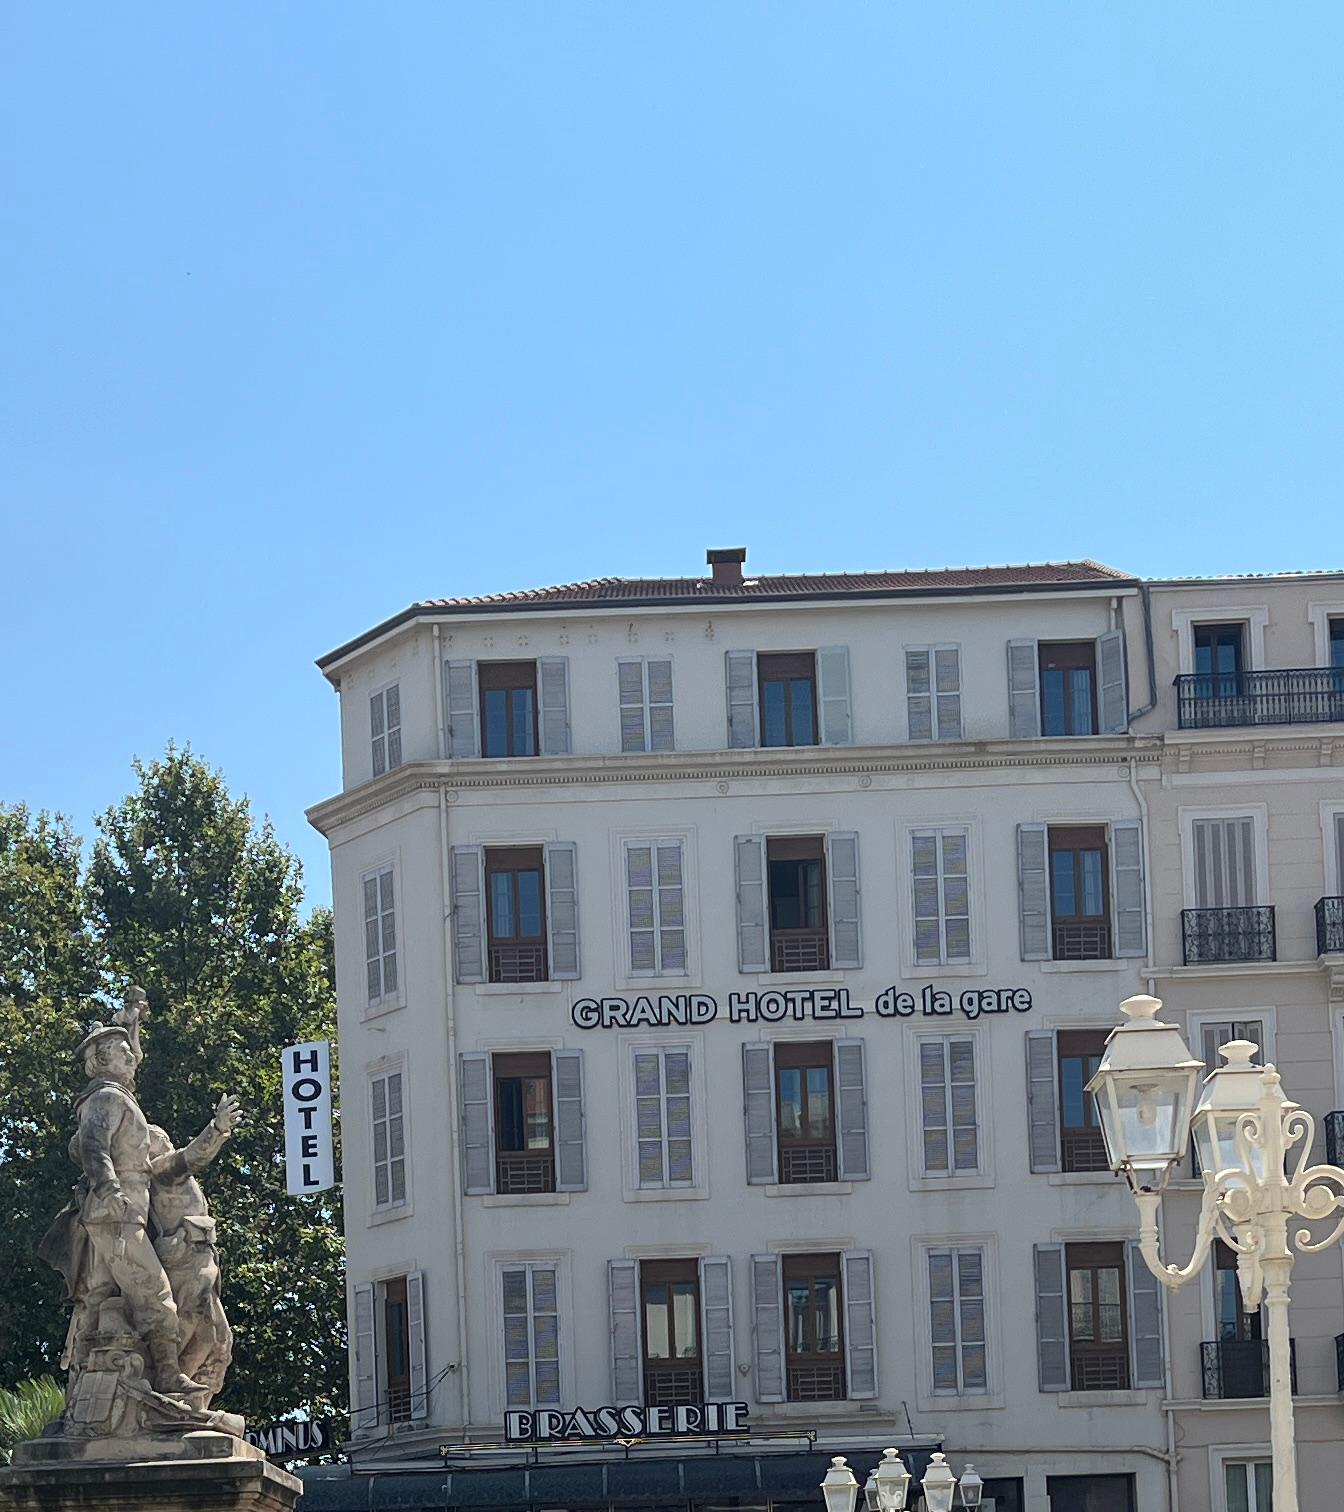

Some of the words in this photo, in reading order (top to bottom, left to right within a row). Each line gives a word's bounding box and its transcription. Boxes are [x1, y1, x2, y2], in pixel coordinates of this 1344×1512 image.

[572, 993, 718, 1030] GRAND
[728, 988, 864, 1023] HOTEL
[875, 985, 915, 1018] de
[922, 984, 953, 1015] la
[959, 986, 1034, 1020] gare
[291, 1050, 323, 1187] HOTEL
[504, 1402, 751, 1442] BRASSERIE
